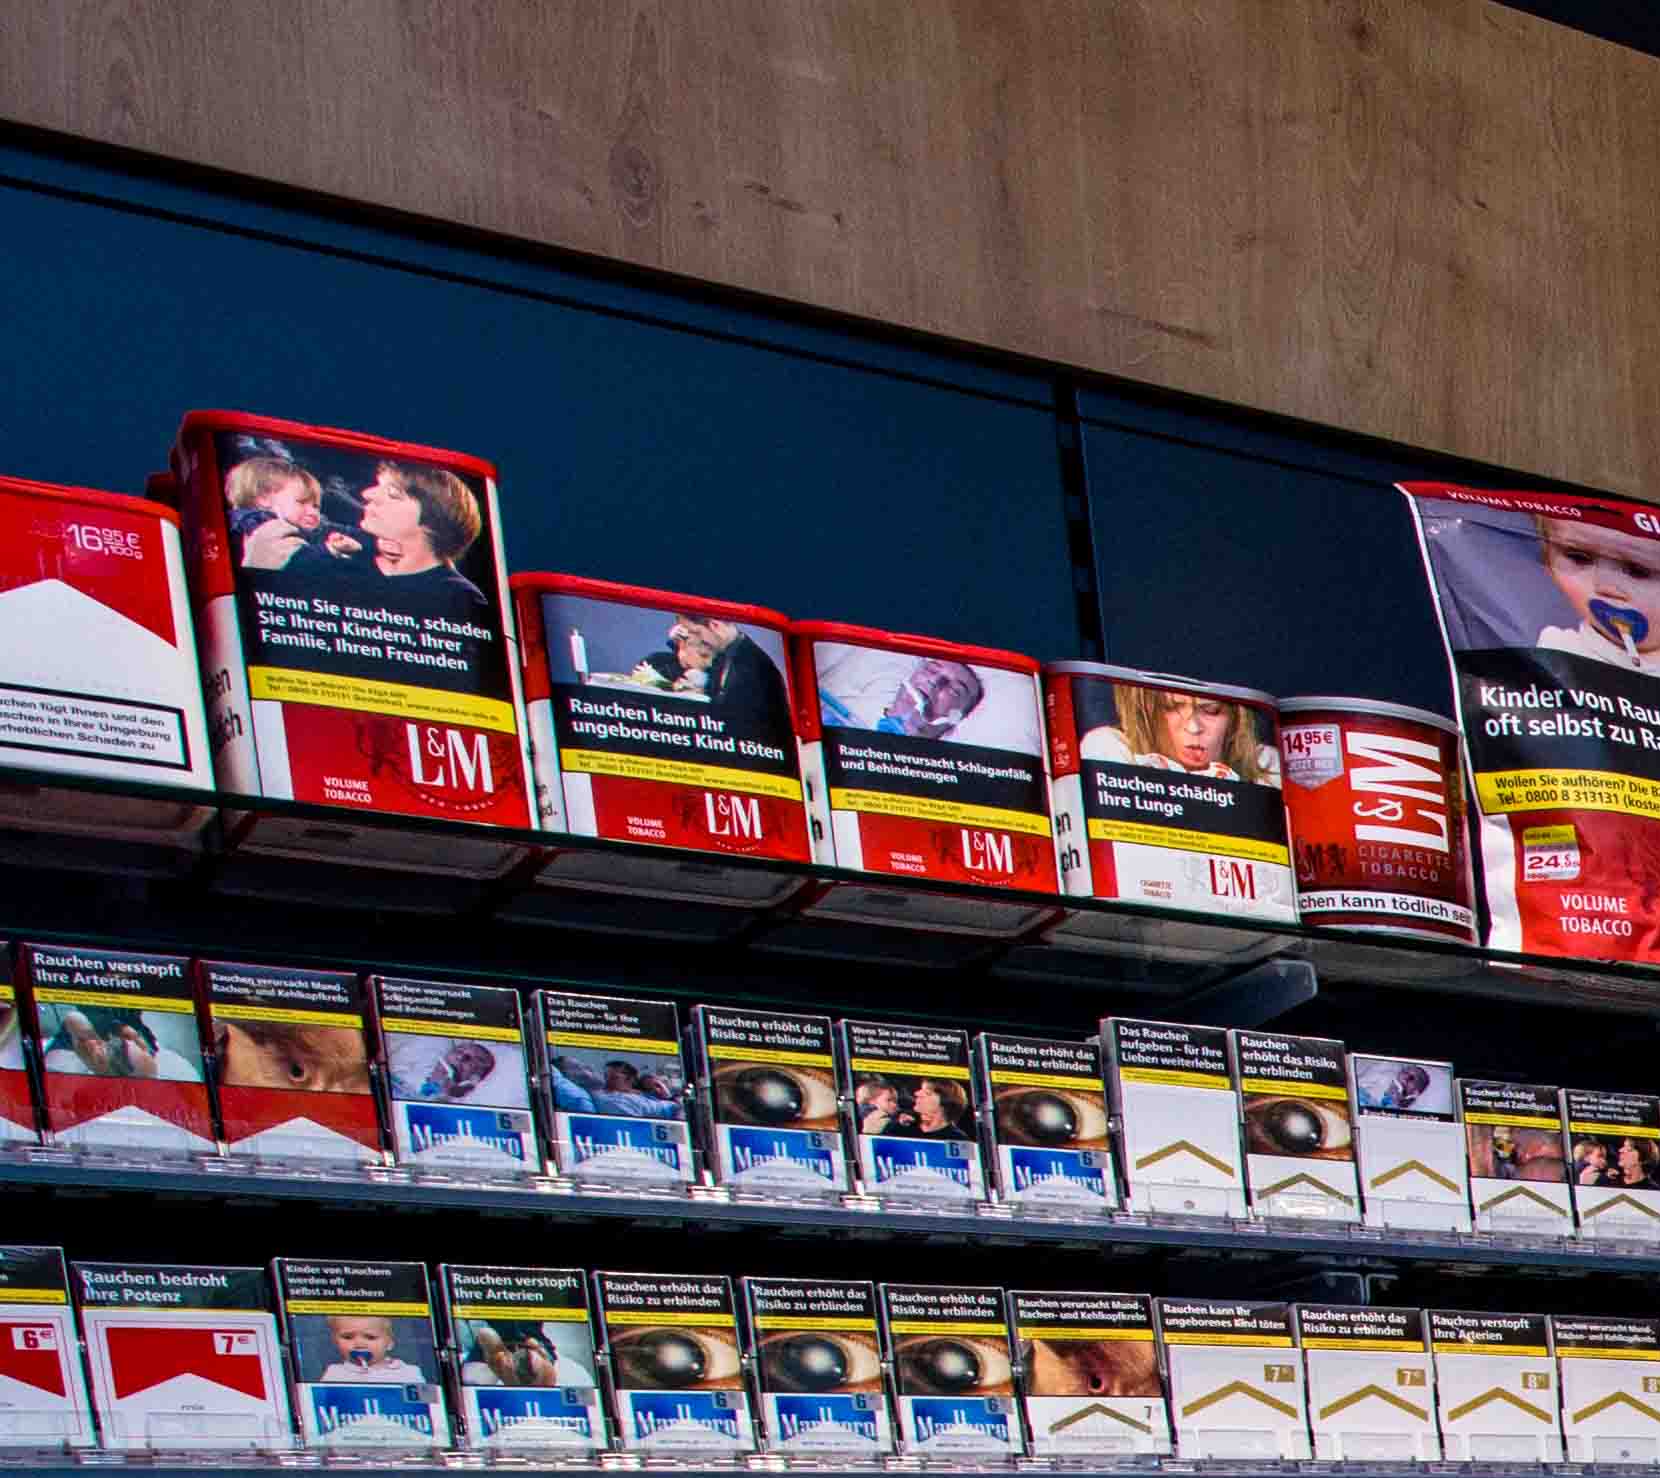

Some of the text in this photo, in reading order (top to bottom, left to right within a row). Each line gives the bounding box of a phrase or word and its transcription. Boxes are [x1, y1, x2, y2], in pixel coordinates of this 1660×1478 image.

[256, 591, 494, 642] Wenn Sie rauchen, schaden
[257, 609, 463, 654] Sie Ihren Kindern, Ihrer
[259, 628, 469, 673] Familie, Ihren Freunden
[1480, 685, 1563, 707] Kinder
[1570, 689, 1614, 713] von
[570, 697, 725, 732] Rauchen kann Ihr
[571, 718, 785, 761] ungeborenes Kind töten
[1485, 714, 1521, 737] oft
[1529, 712, 1603, 738] selbst
[1609, 723, 1636, 746] zu
[406, 721, 495, 794] L&M
[324, 775, 369, 792] VOLUME
[324, 788, 373, 804] TOBACCO
[1095, 771, 1235, 809] Rauchen schädigt
[1346, 731, 1449, 852] L&M
[1495, 775, 1537, 789] Wollen
[1540, 775, 1558, 787] Sie
[1561, 775, 1626, 791] aufhören?
[1628, 780, 1649, 795] Die
[1497, 792, 1522, 806] Tel.:
[1525, 789, 1558, 803] 0800
[1561, 789, 1570, 801] 8
[1573, 789, 1619, 805] 313131
[1098, 790, 1185, 818] Ihre Lunge
[1560, 893, 1628, 914] VOLUME
[1560, 915, 1632, 937] TOBACCO
[82, 1269, 229, 1290] Rauchen bedroht
[84, 1285, 182, 1307] Ihre Potenz
